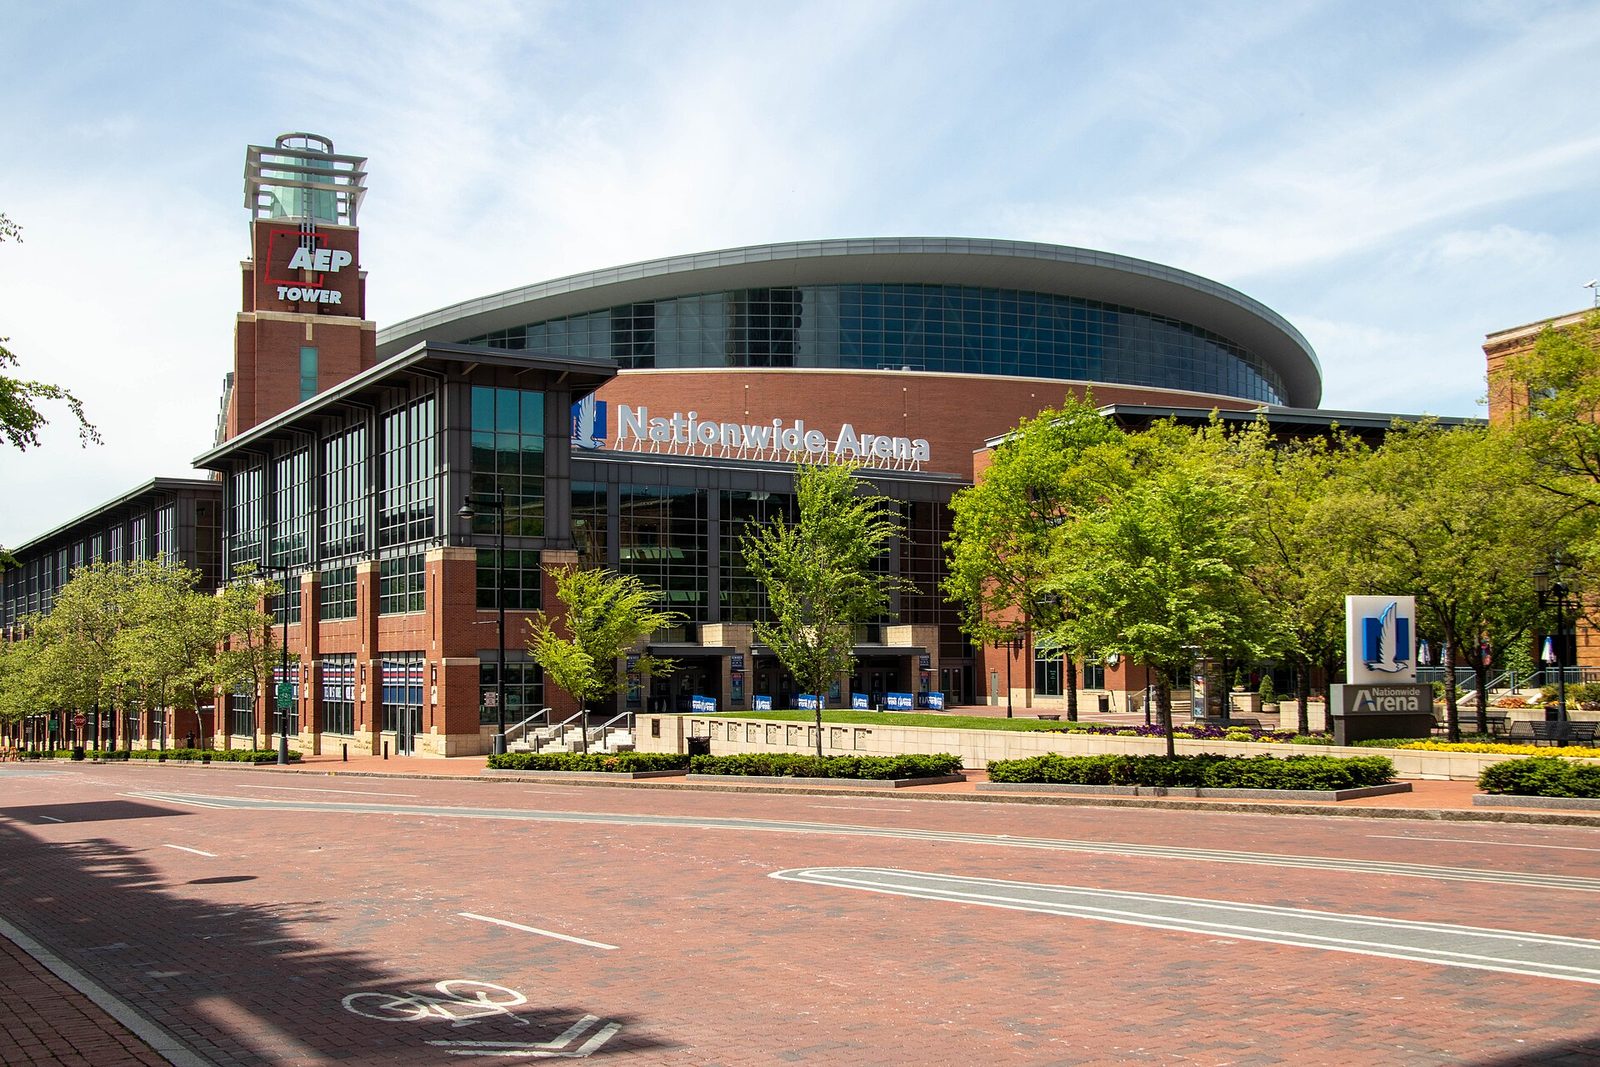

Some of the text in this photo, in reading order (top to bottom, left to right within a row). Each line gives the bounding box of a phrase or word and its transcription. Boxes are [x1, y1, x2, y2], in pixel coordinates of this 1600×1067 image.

[288, 247, 352, 272] AEP
[277, 286, 342, 304] TOWER
[617, 404, 930, 462] Nationwide Arena
[1352, 689, 1419, 712] Arena
[1372, 687, 1420, 696] Nationwide
